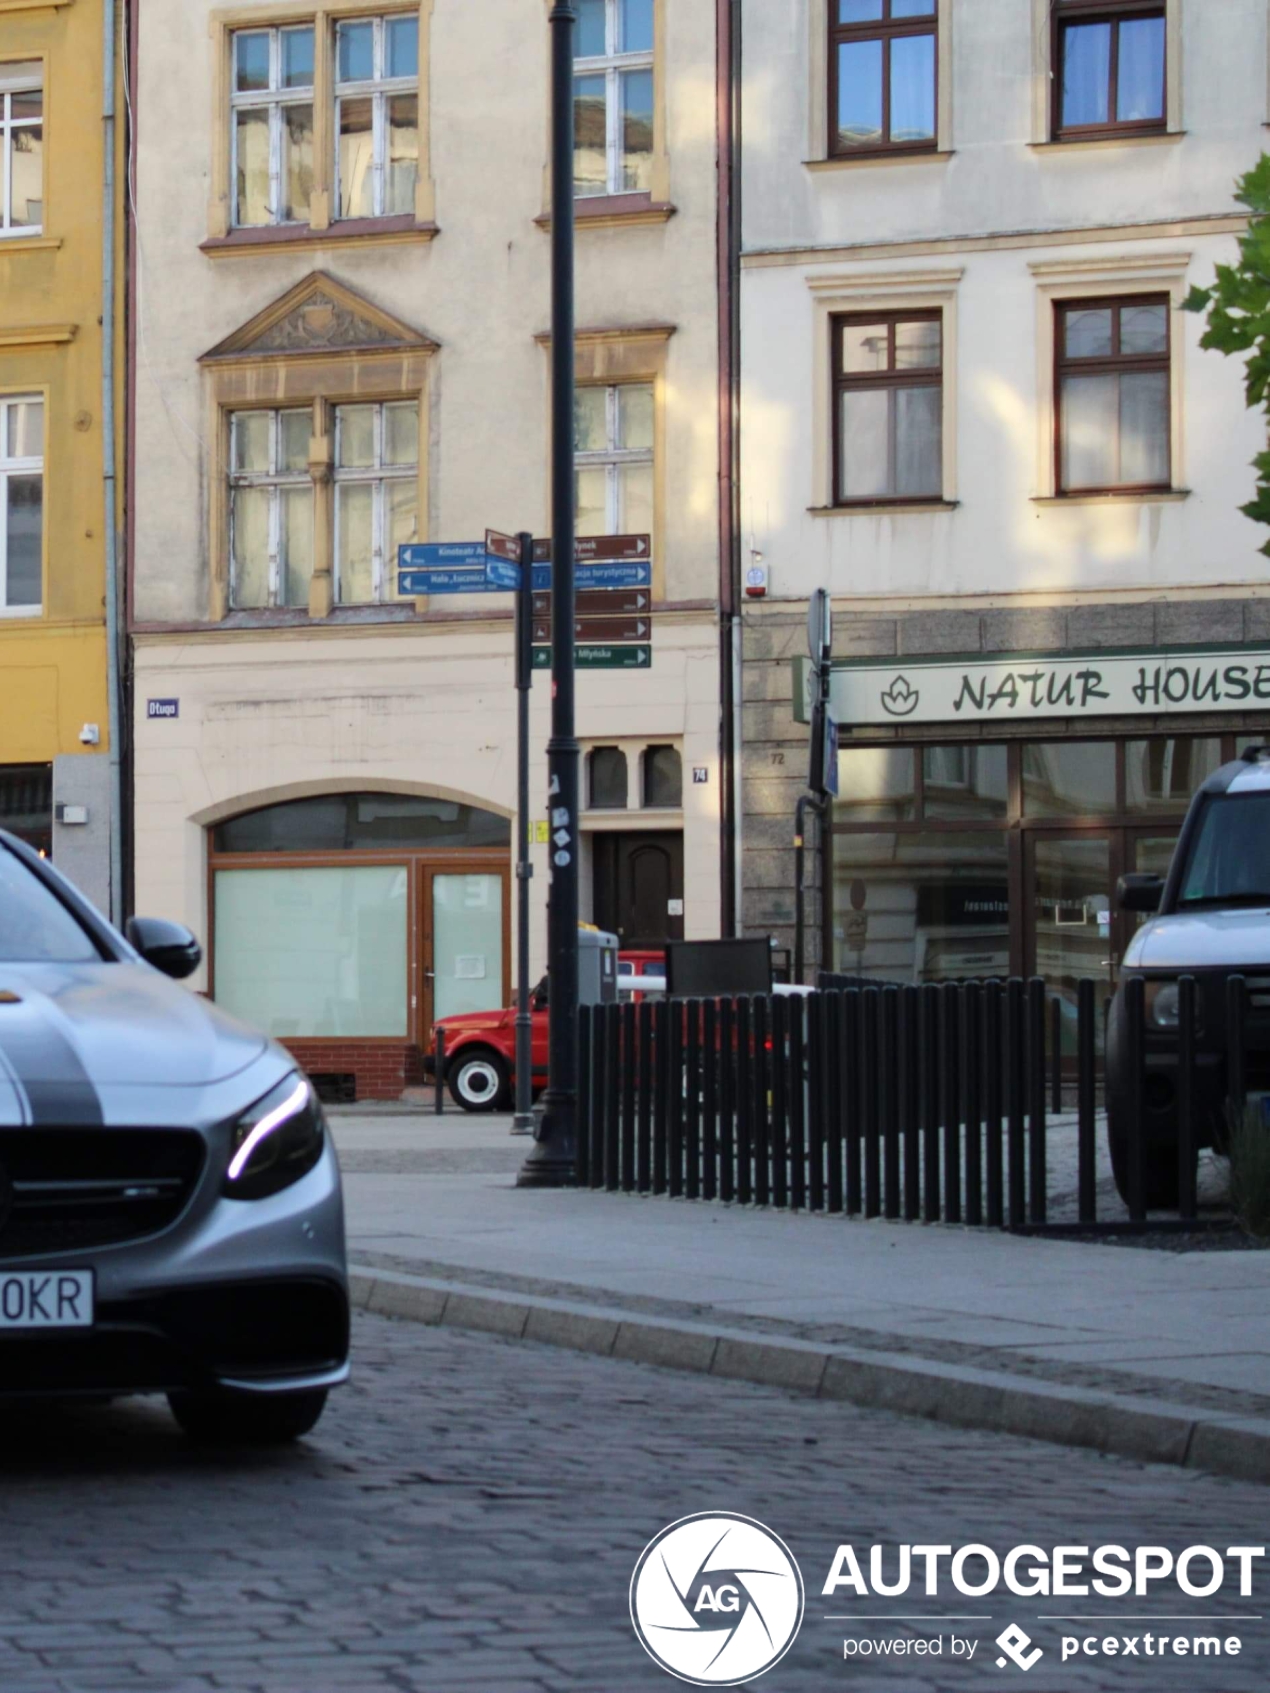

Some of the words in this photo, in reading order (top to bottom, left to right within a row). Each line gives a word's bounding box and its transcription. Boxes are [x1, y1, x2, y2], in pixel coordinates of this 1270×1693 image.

[953, 667, 1111, 712] NATUR
[1132, 664, 1270, 706] HOUSE
[770, 752, 785, 765] 72
[694, 769, 706, 782] 74
